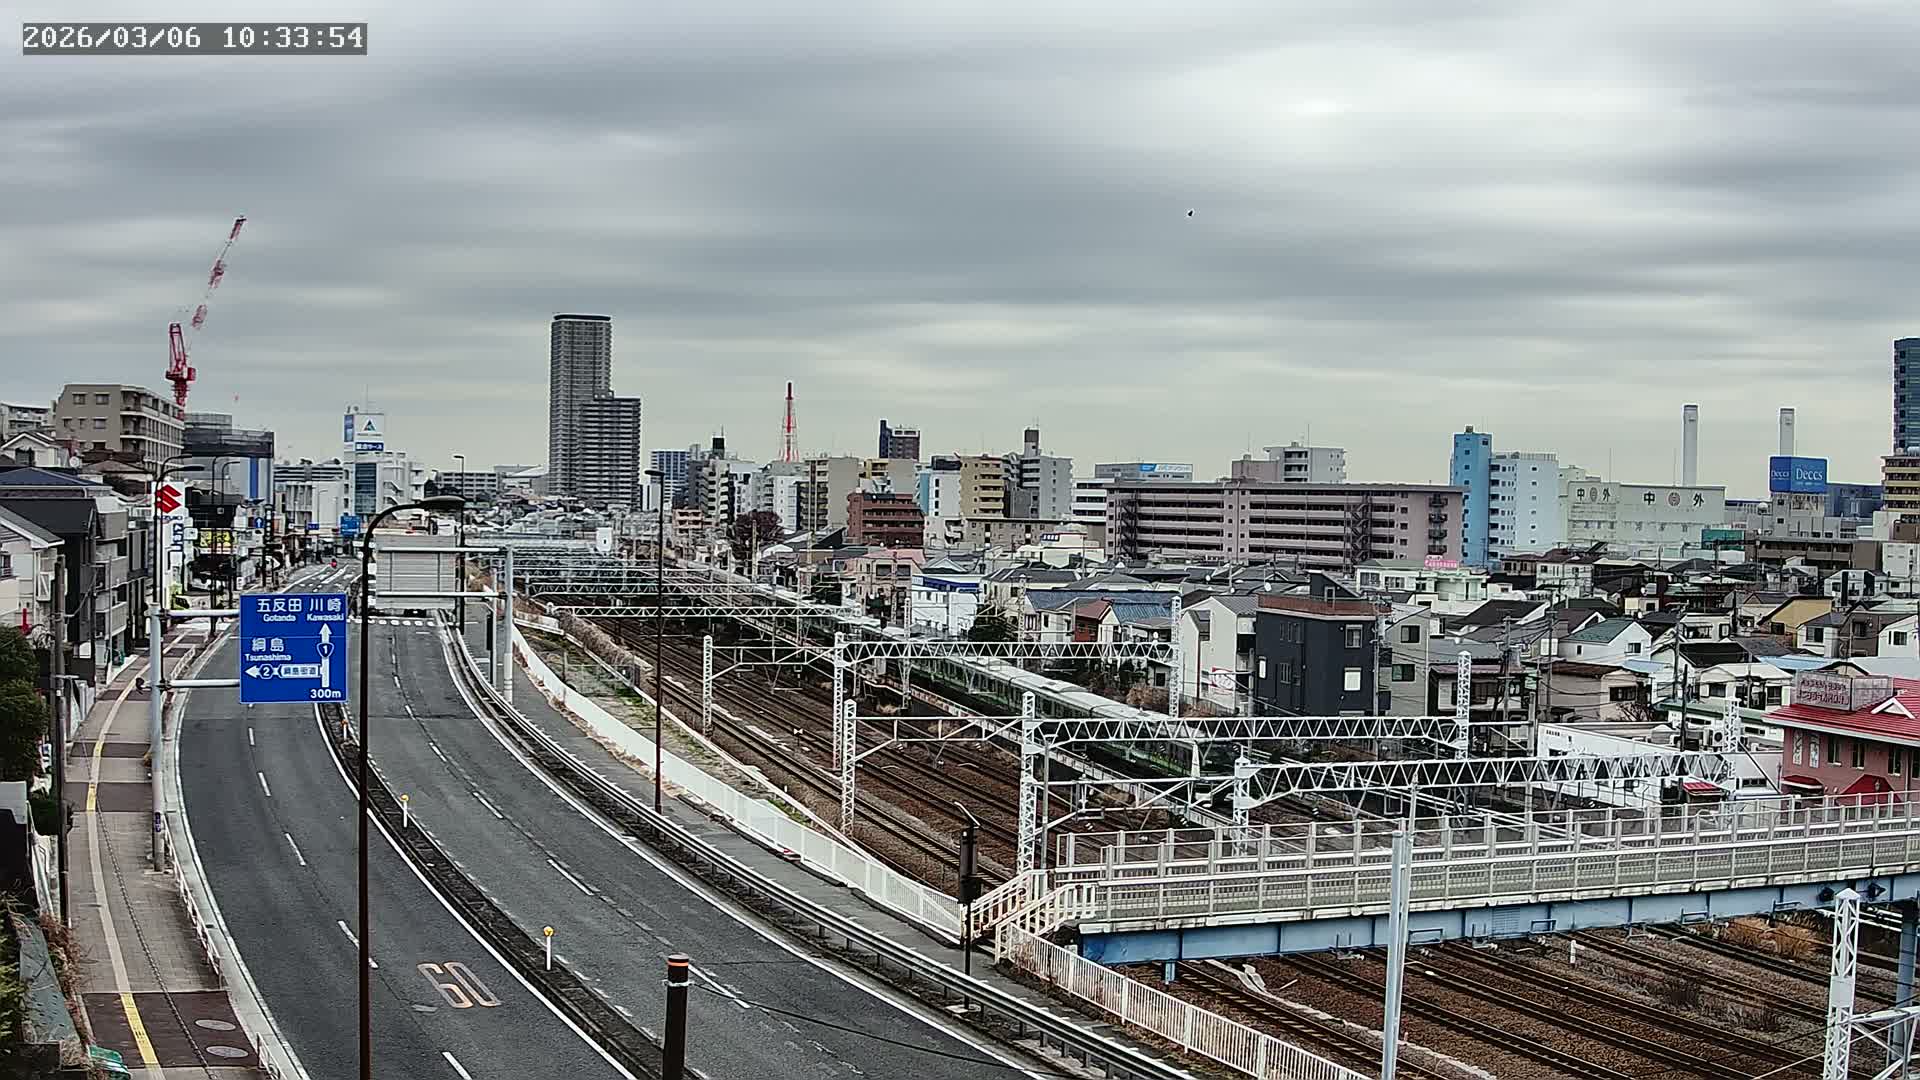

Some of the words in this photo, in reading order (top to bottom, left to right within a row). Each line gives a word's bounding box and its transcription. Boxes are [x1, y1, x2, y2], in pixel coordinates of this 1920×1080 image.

[1796, 467, 1823, 480] Deccs
[257, 598, 302, 612] 五反田
[309, 598, 342, 612] 川崎
[263, 614, 296, 622] Gotanda
[306, 613, 344, 621] Kawasaki
[251, 637, 284, 652] 綱島
[244, 653, 292, 662] Tsunashima
[263, 667, 270, 677] 2
[310, 689, 342, 699] 300m
[416, 962, 502, 1008] 60
